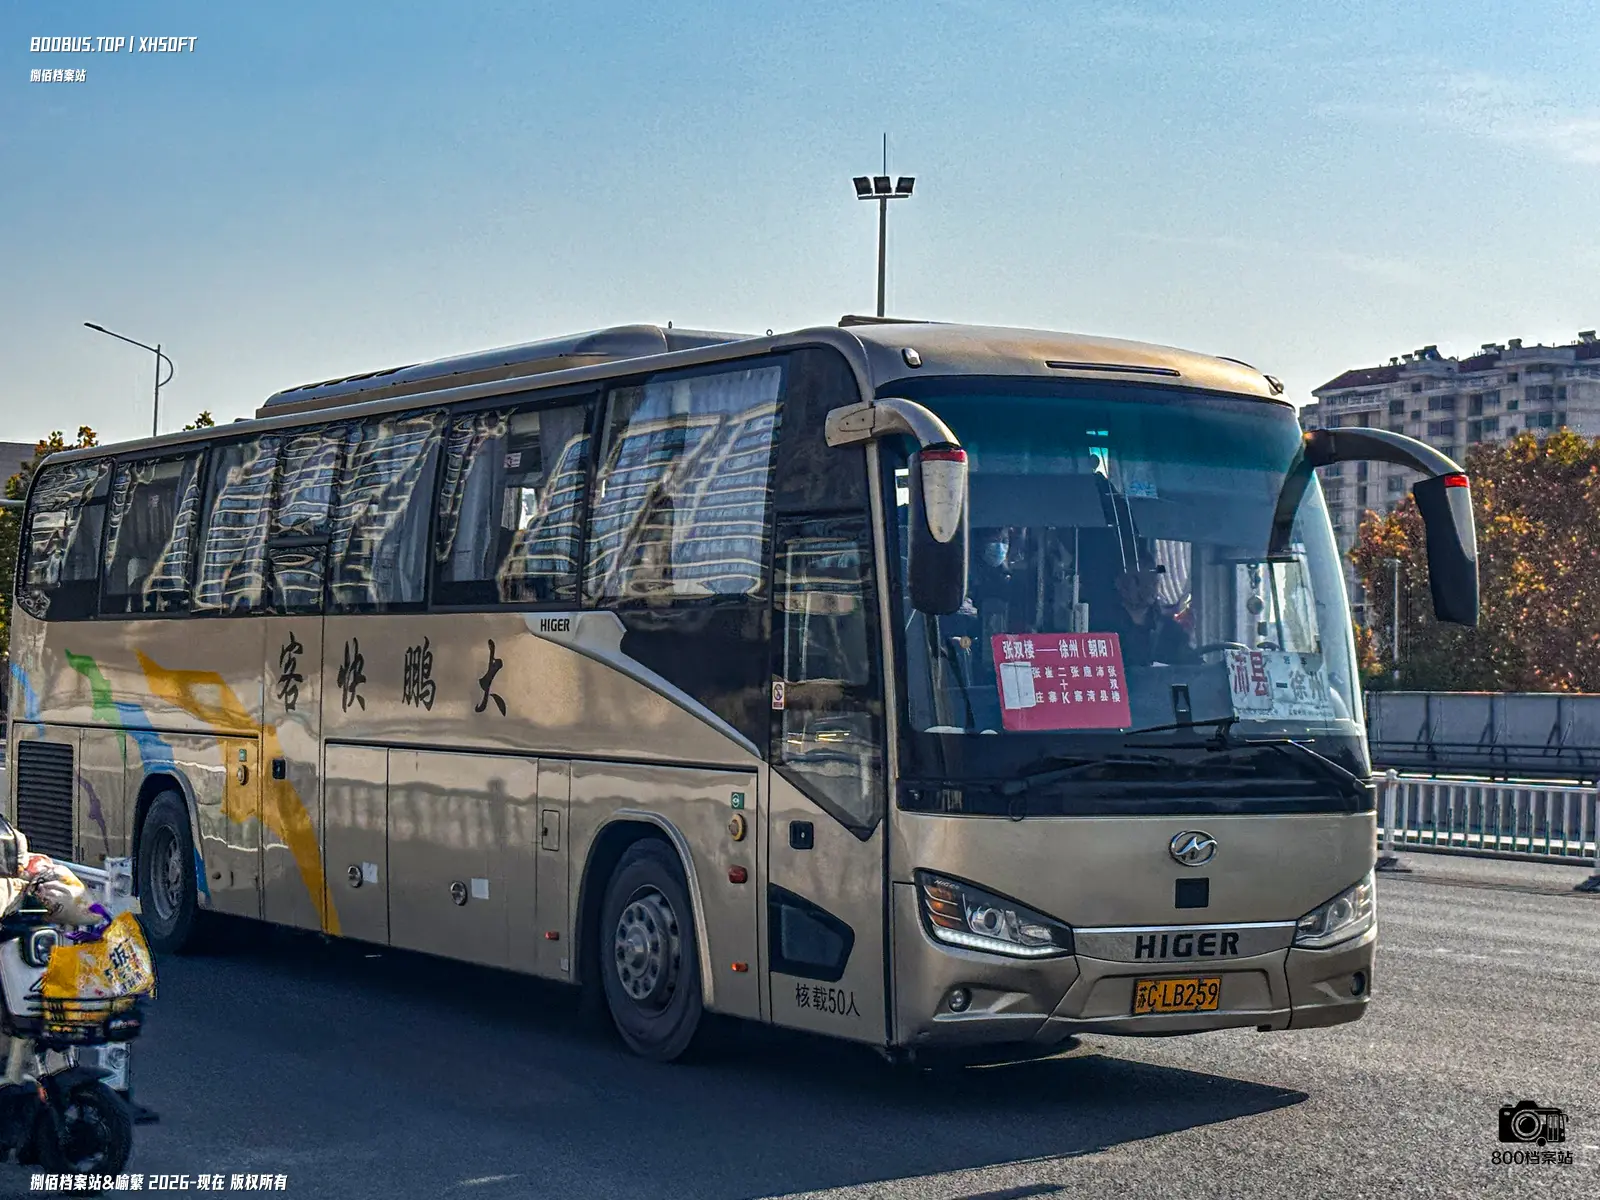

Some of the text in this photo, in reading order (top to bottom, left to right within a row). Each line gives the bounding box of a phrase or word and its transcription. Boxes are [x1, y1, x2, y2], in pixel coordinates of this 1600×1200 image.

[540, 618, 570, 633] HIGER
[1135, 932, 1239, 959] HIGER
[796, 983, 861, 1017] 核载50人
